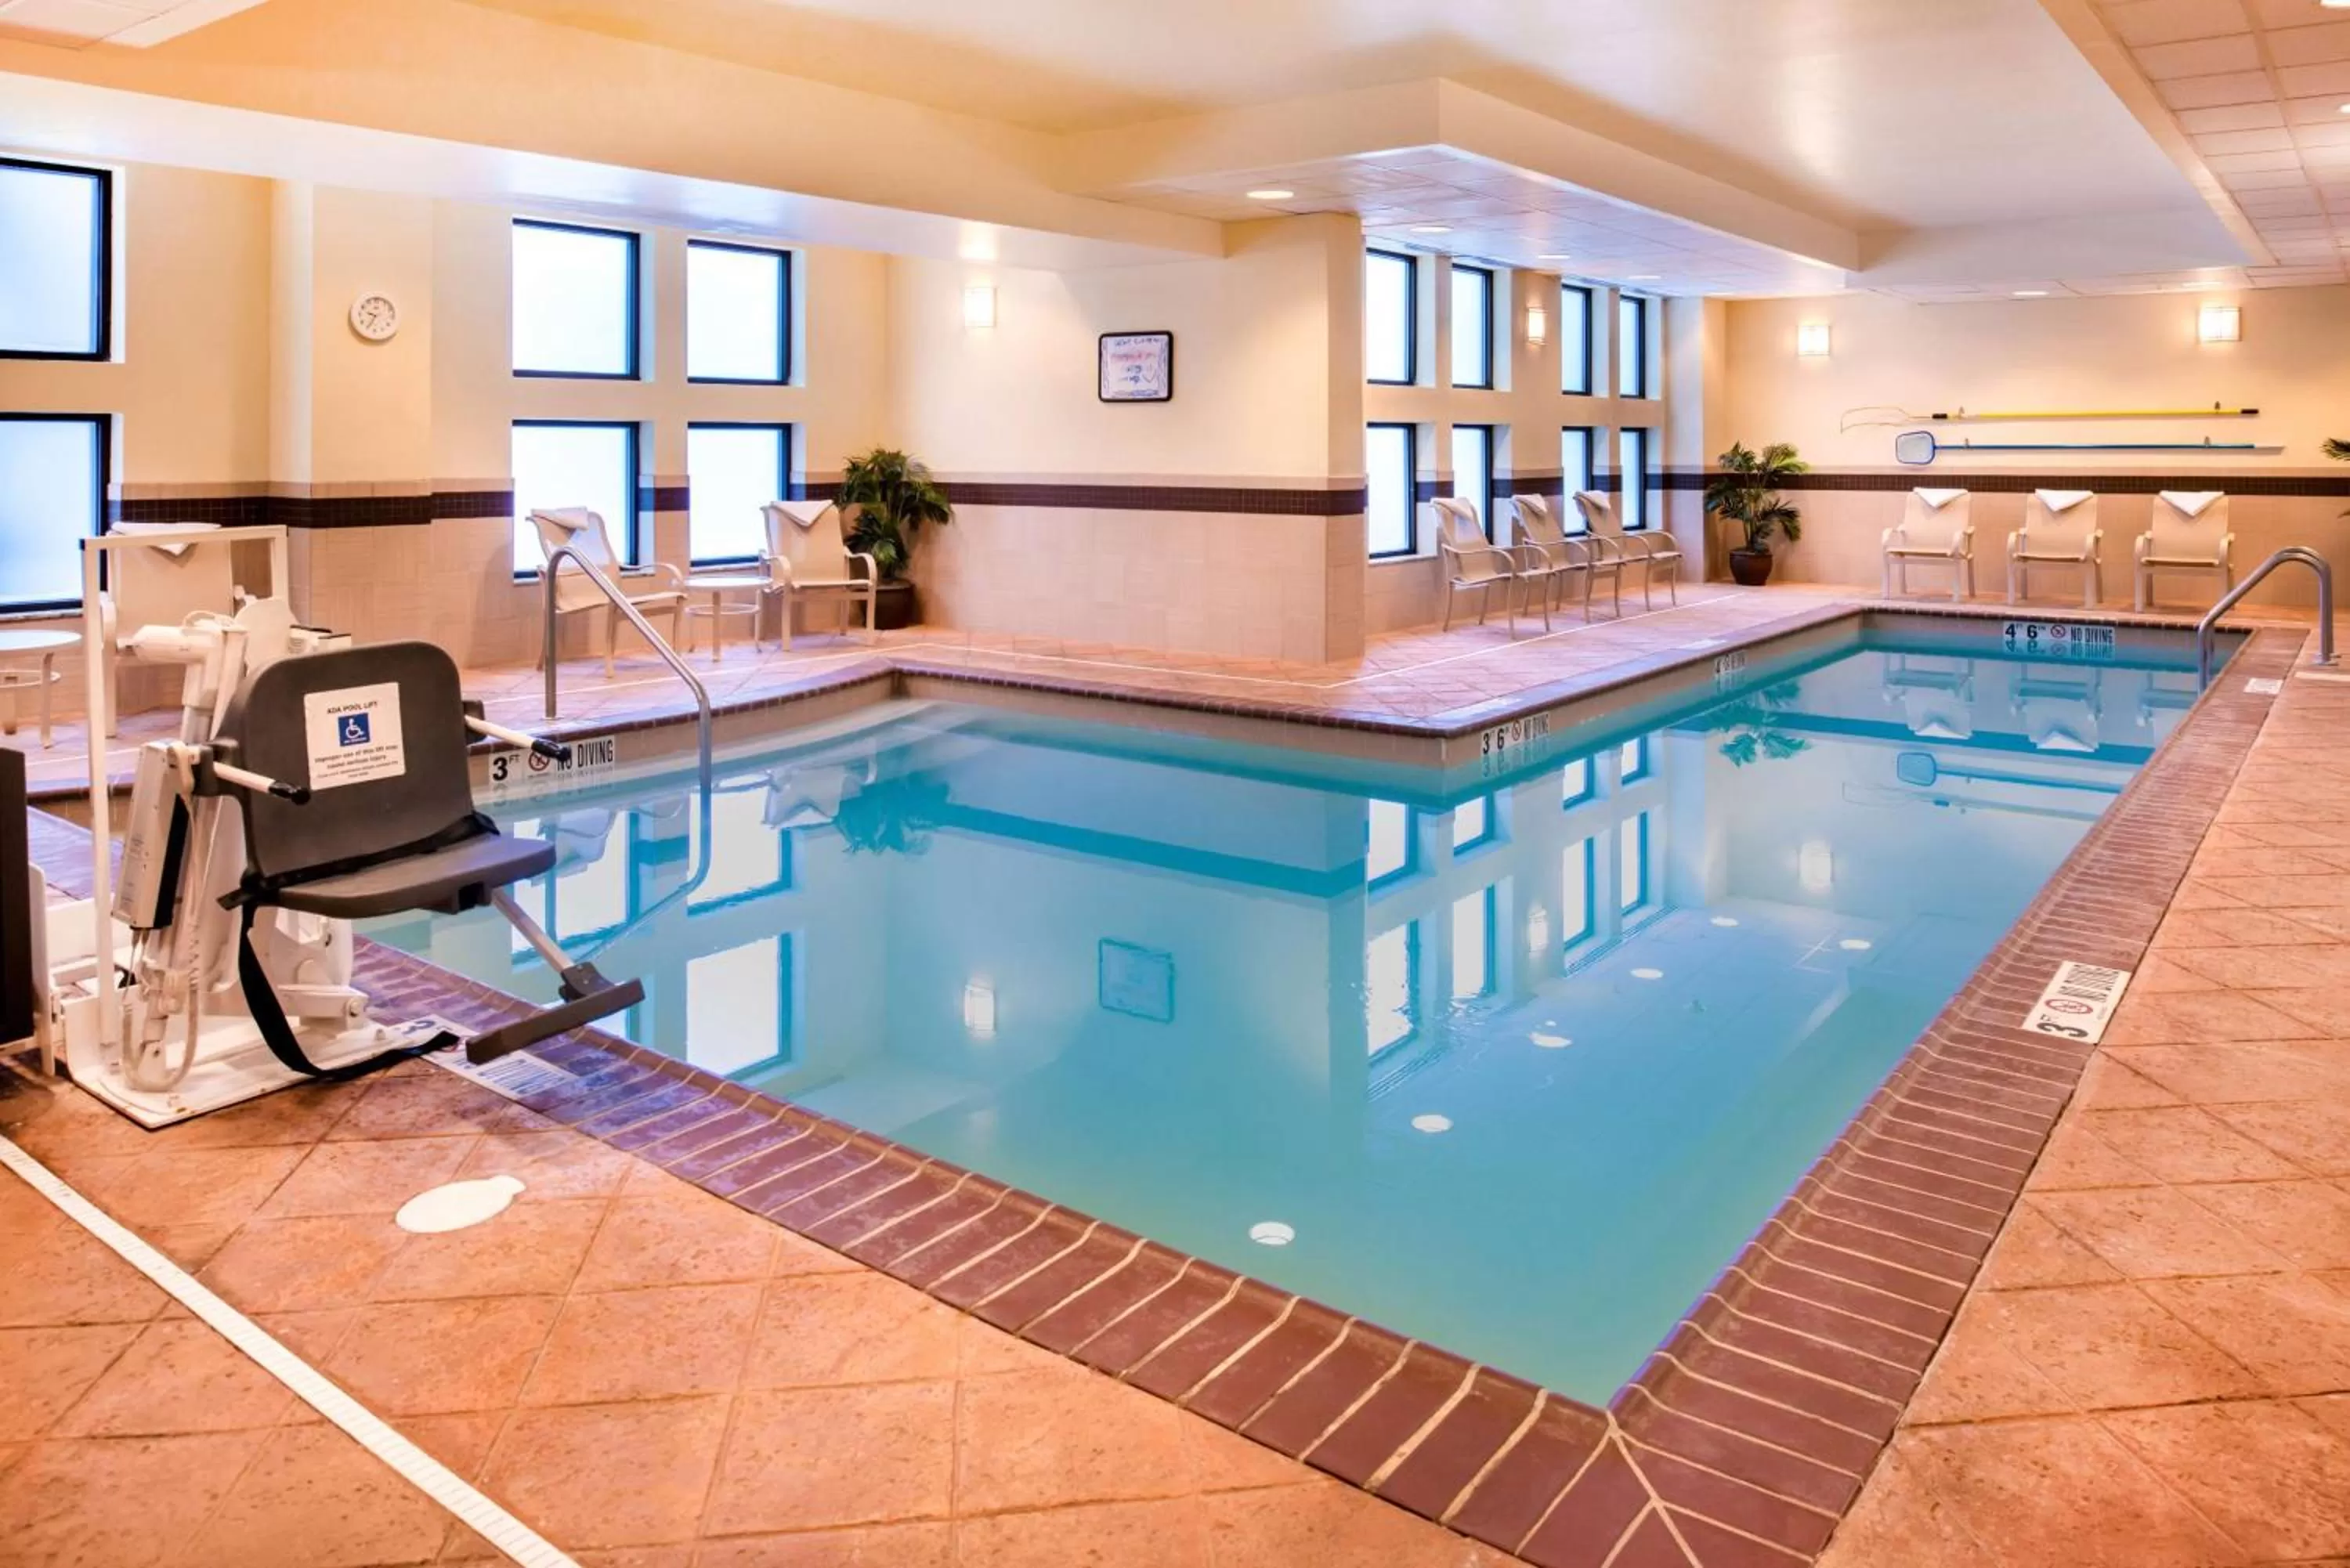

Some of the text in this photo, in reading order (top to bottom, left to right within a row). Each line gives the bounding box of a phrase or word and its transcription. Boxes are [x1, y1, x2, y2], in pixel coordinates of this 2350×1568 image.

[2005, 623, 2016, 638] 4
[2027, 625, 2037, 639] 6
[2071, 626, 2082, 641] NO
[2084, 628, 2113, 644] DIVING
[327, 700, 378, 714] ADA POOL LIFT
[1483, 732, 1490, 754] 3
[1497, 728, 1505, 750] 6
[493, 757, 508, 781] 3
[577, 739, 613, 768] DIVING
[2037, 1022, 2088, 1038] 3
